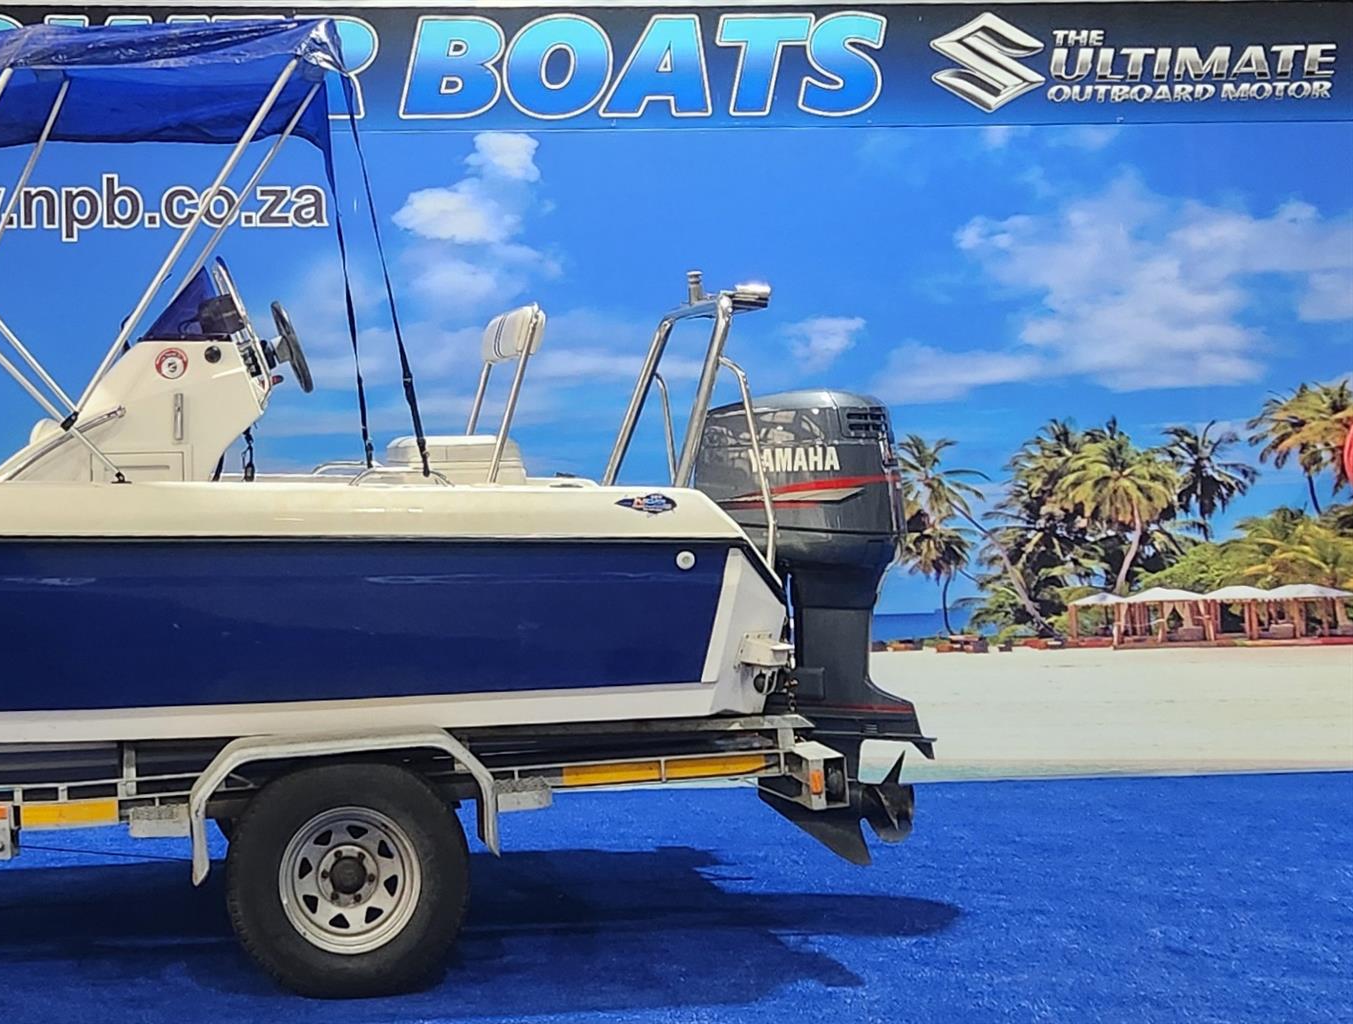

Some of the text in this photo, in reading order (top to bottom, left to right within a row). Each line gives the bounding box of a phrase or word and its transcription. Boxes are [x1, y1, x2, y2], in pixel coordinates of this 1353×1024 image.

[1053, 29, 1105, 46] THE
[398, 10, 887, 120] BOATS
[1049, 43, 1338, 82] ULTIMATE
[1047, 80, 1333, 103] OUTBOARD MOTOR
[748, 445, 841, 473] YAMAHA
